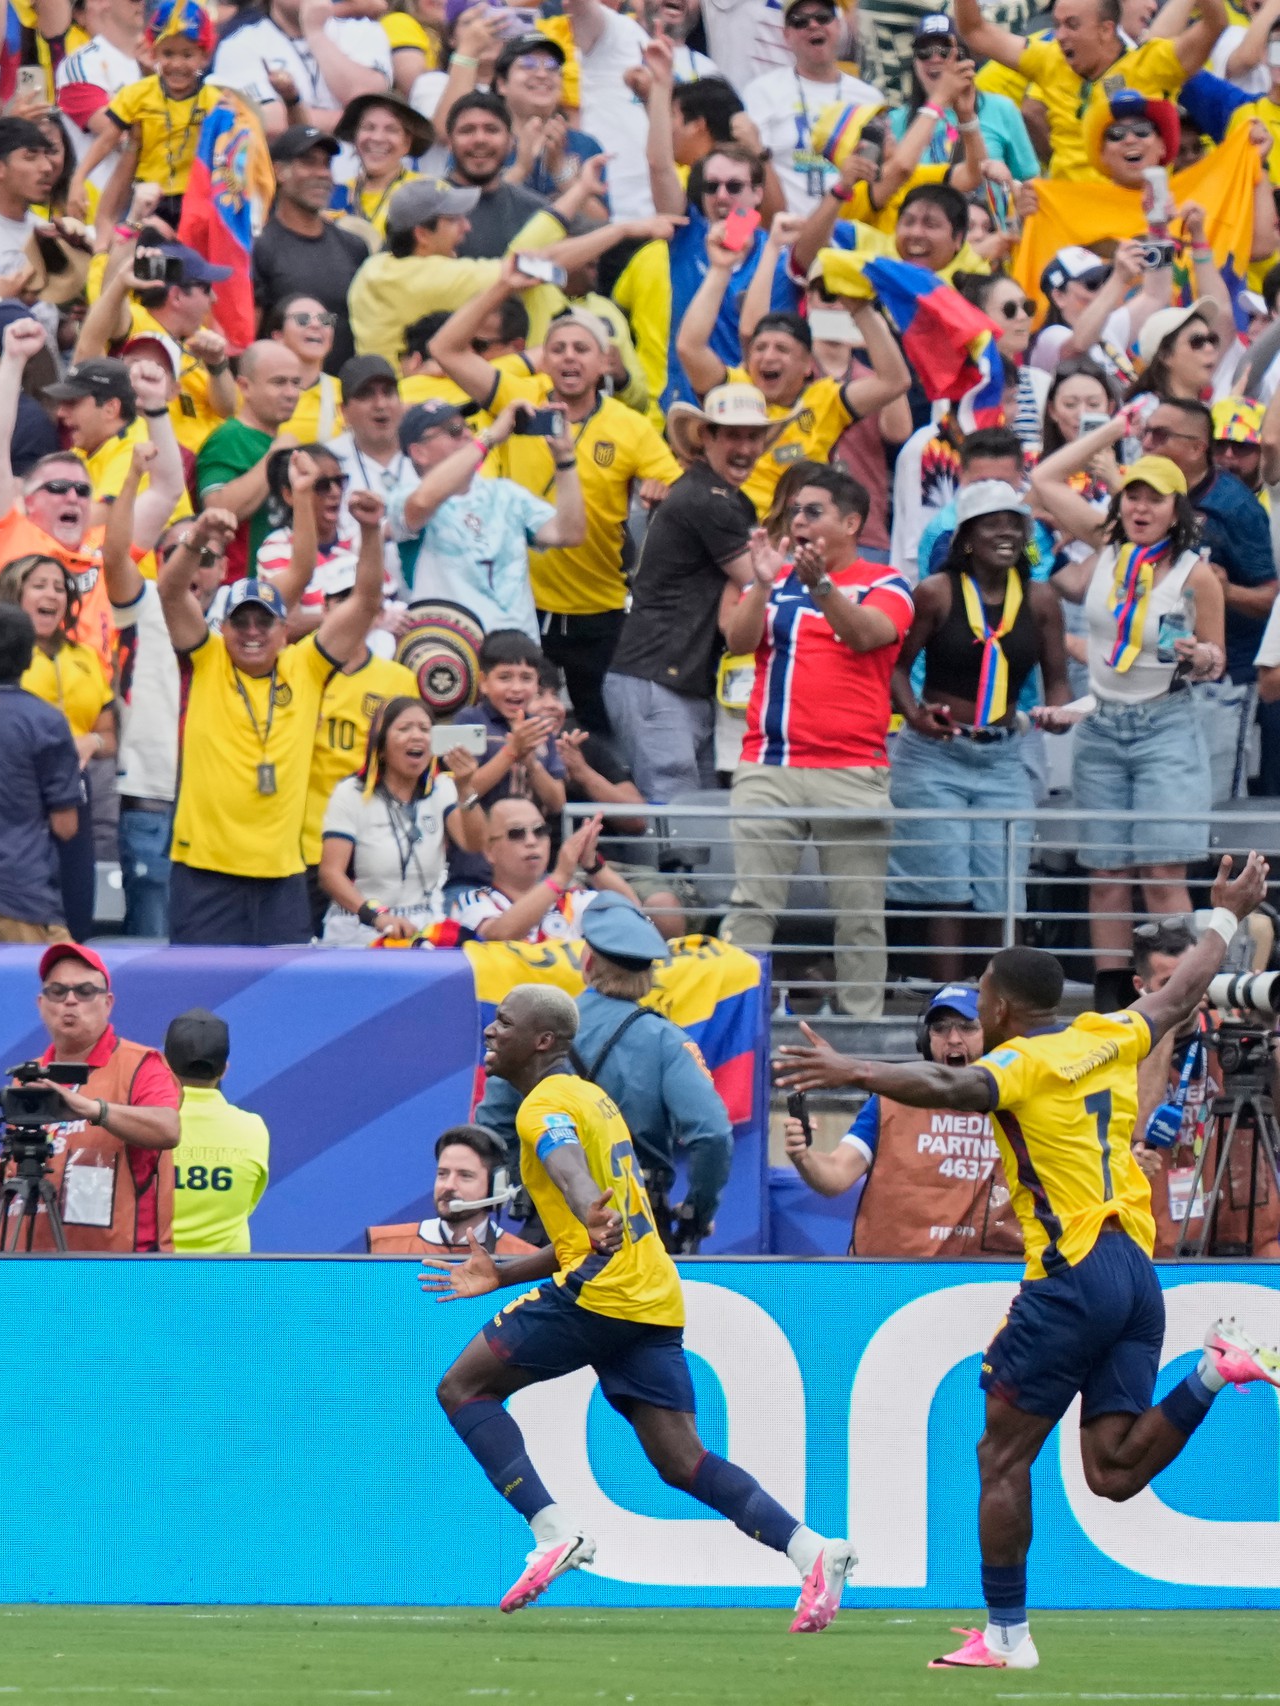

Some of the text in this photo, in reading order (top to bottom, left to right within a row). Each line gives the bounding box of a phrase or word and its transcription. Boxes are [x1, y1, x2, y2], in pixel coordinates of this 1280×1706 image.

[328, 716, 356, 751] 10
[917, 1133, 1002, 1159] PARTNE
[1084, 1088, 1113, 1203] 7
[174, 1165, 233, 1192] 186
[939, 1157, 995, 1181] 4637
